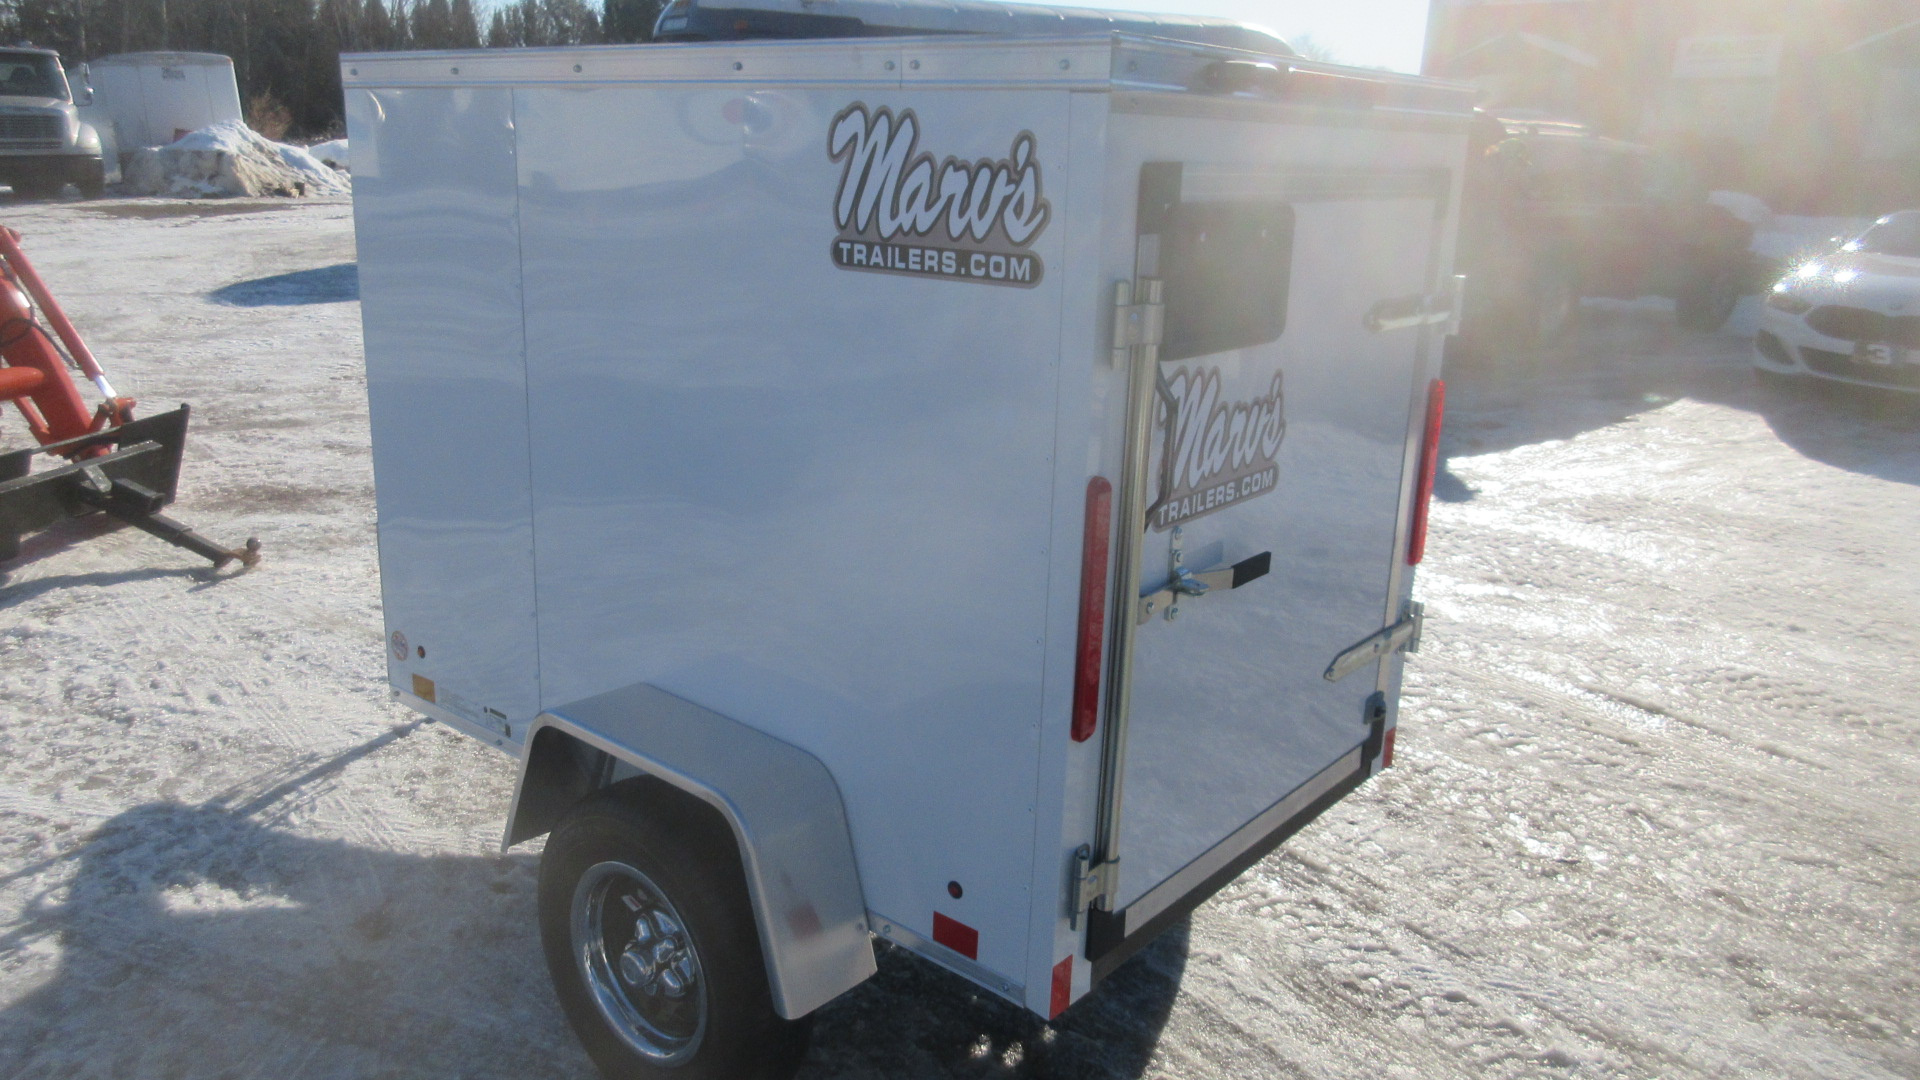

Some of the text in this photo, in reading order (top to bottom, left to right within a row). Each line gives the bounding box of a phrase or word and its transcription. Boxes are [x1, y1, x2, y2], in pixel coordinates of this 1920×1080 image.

[832, 106, 1045, 243] Marv's
[838, 241, 1031, 281] TRAILERS.COM
[1158, 468, 1273, 526] TRAILERS.COM
